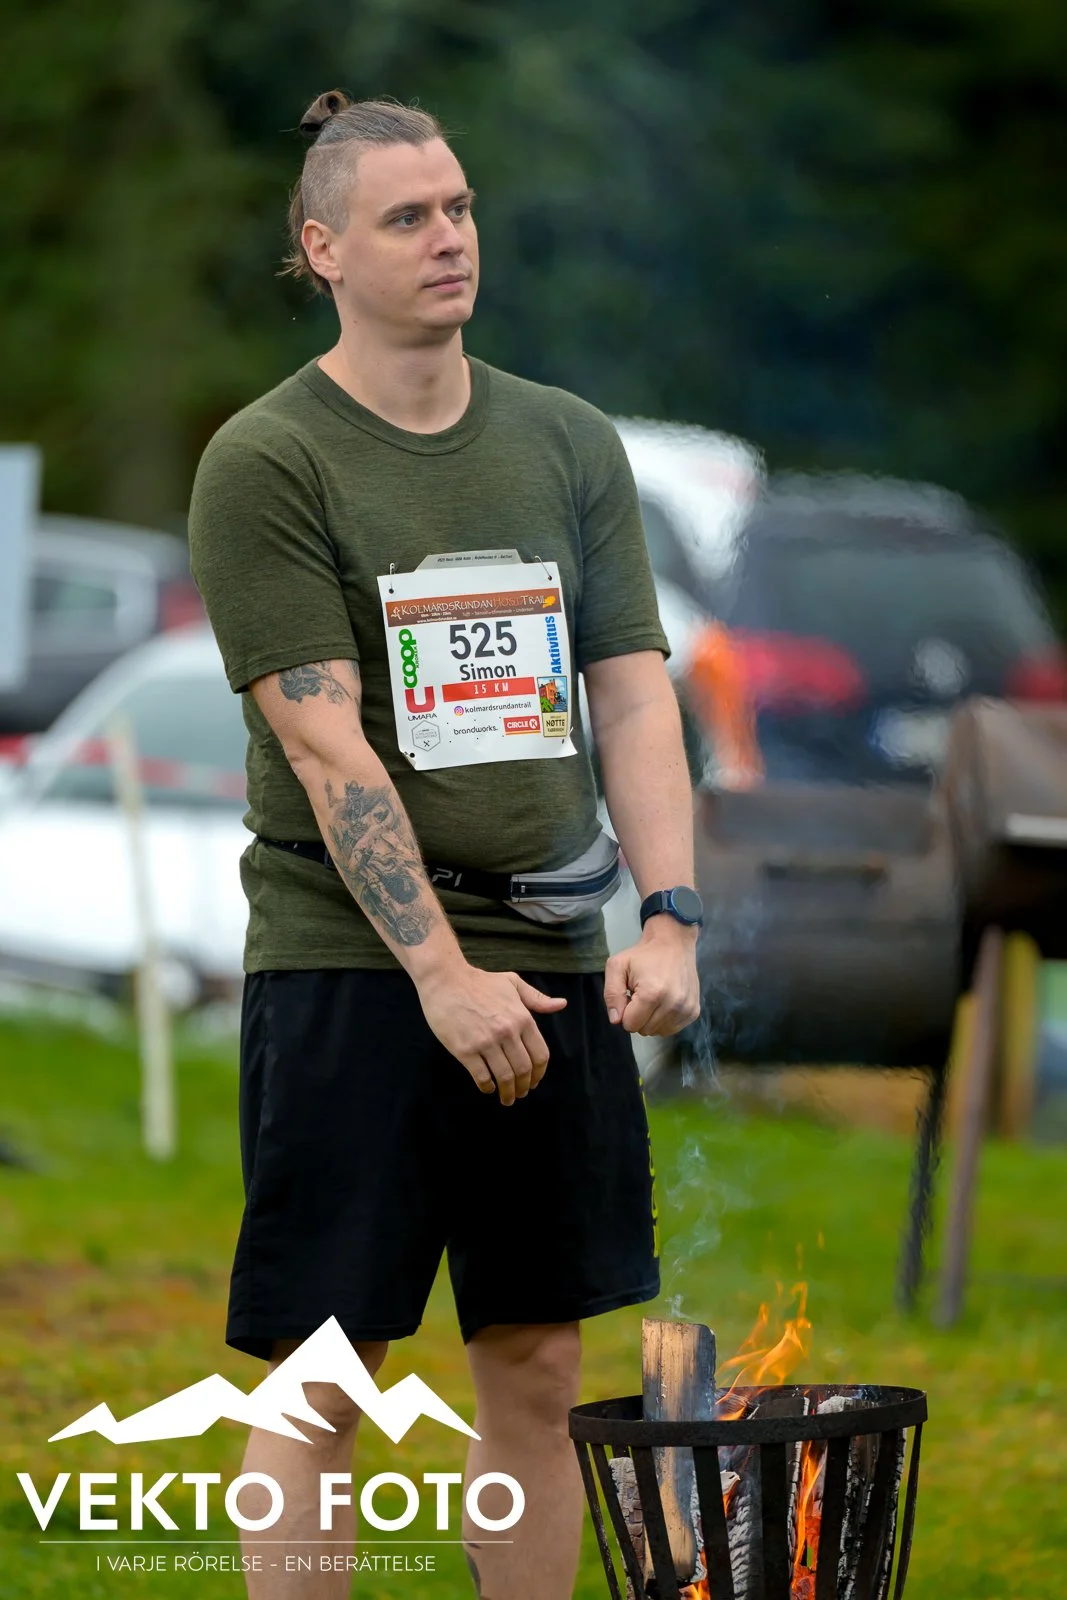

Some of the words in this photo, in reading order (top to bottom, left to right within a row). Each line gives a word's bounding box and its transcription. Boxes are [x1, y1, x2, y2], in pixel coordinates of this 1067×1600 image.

[449, 620, 517, 660] 525
[544, 615, 562, 674] Aktivitus
[459, 663, 517, 681] Simon
[474, 684, 487, 695] 15
[494, 682, 509, 693] KM
[407, 712, 438, 722] UMARA
[506, 720, 529, 729] CIRCLE
